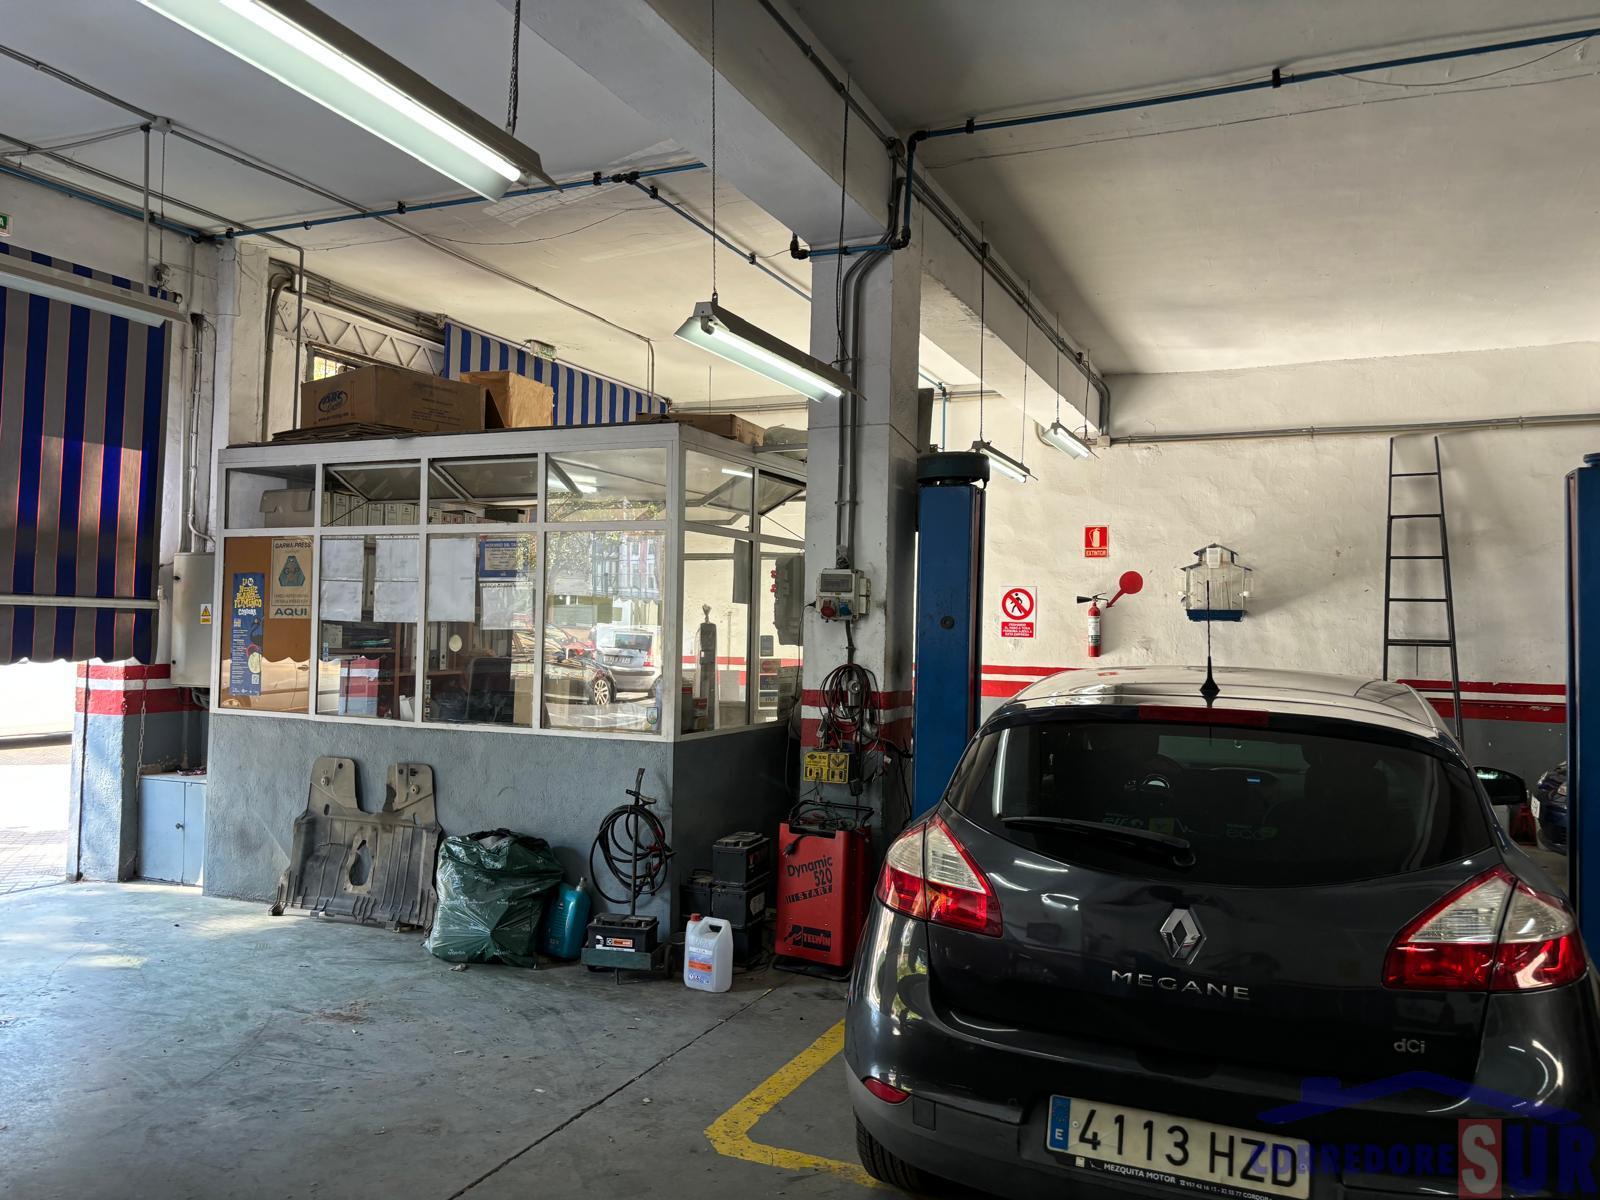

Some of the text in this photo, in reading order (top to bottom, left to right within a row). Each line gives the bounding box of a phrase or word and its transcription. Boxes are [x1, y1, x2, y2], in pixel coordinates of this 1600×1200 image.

[274, 608, 307, 617] AQUI
[787, 854, 832, 877] Dynamic
[814, 868, 832, 887] 520
[1111, 969, 1250, 1000] MEGANE
[1393, 1037, 1425, 1054] dCi
[1055, 1128, 1064, 1140] E
[1078, 1109, 1297, 1188] 4113 HZD
[1103, 1163, 1145, 1178] MEZQUITA
[1146, 1171, 1176, 1185] MOTOR
